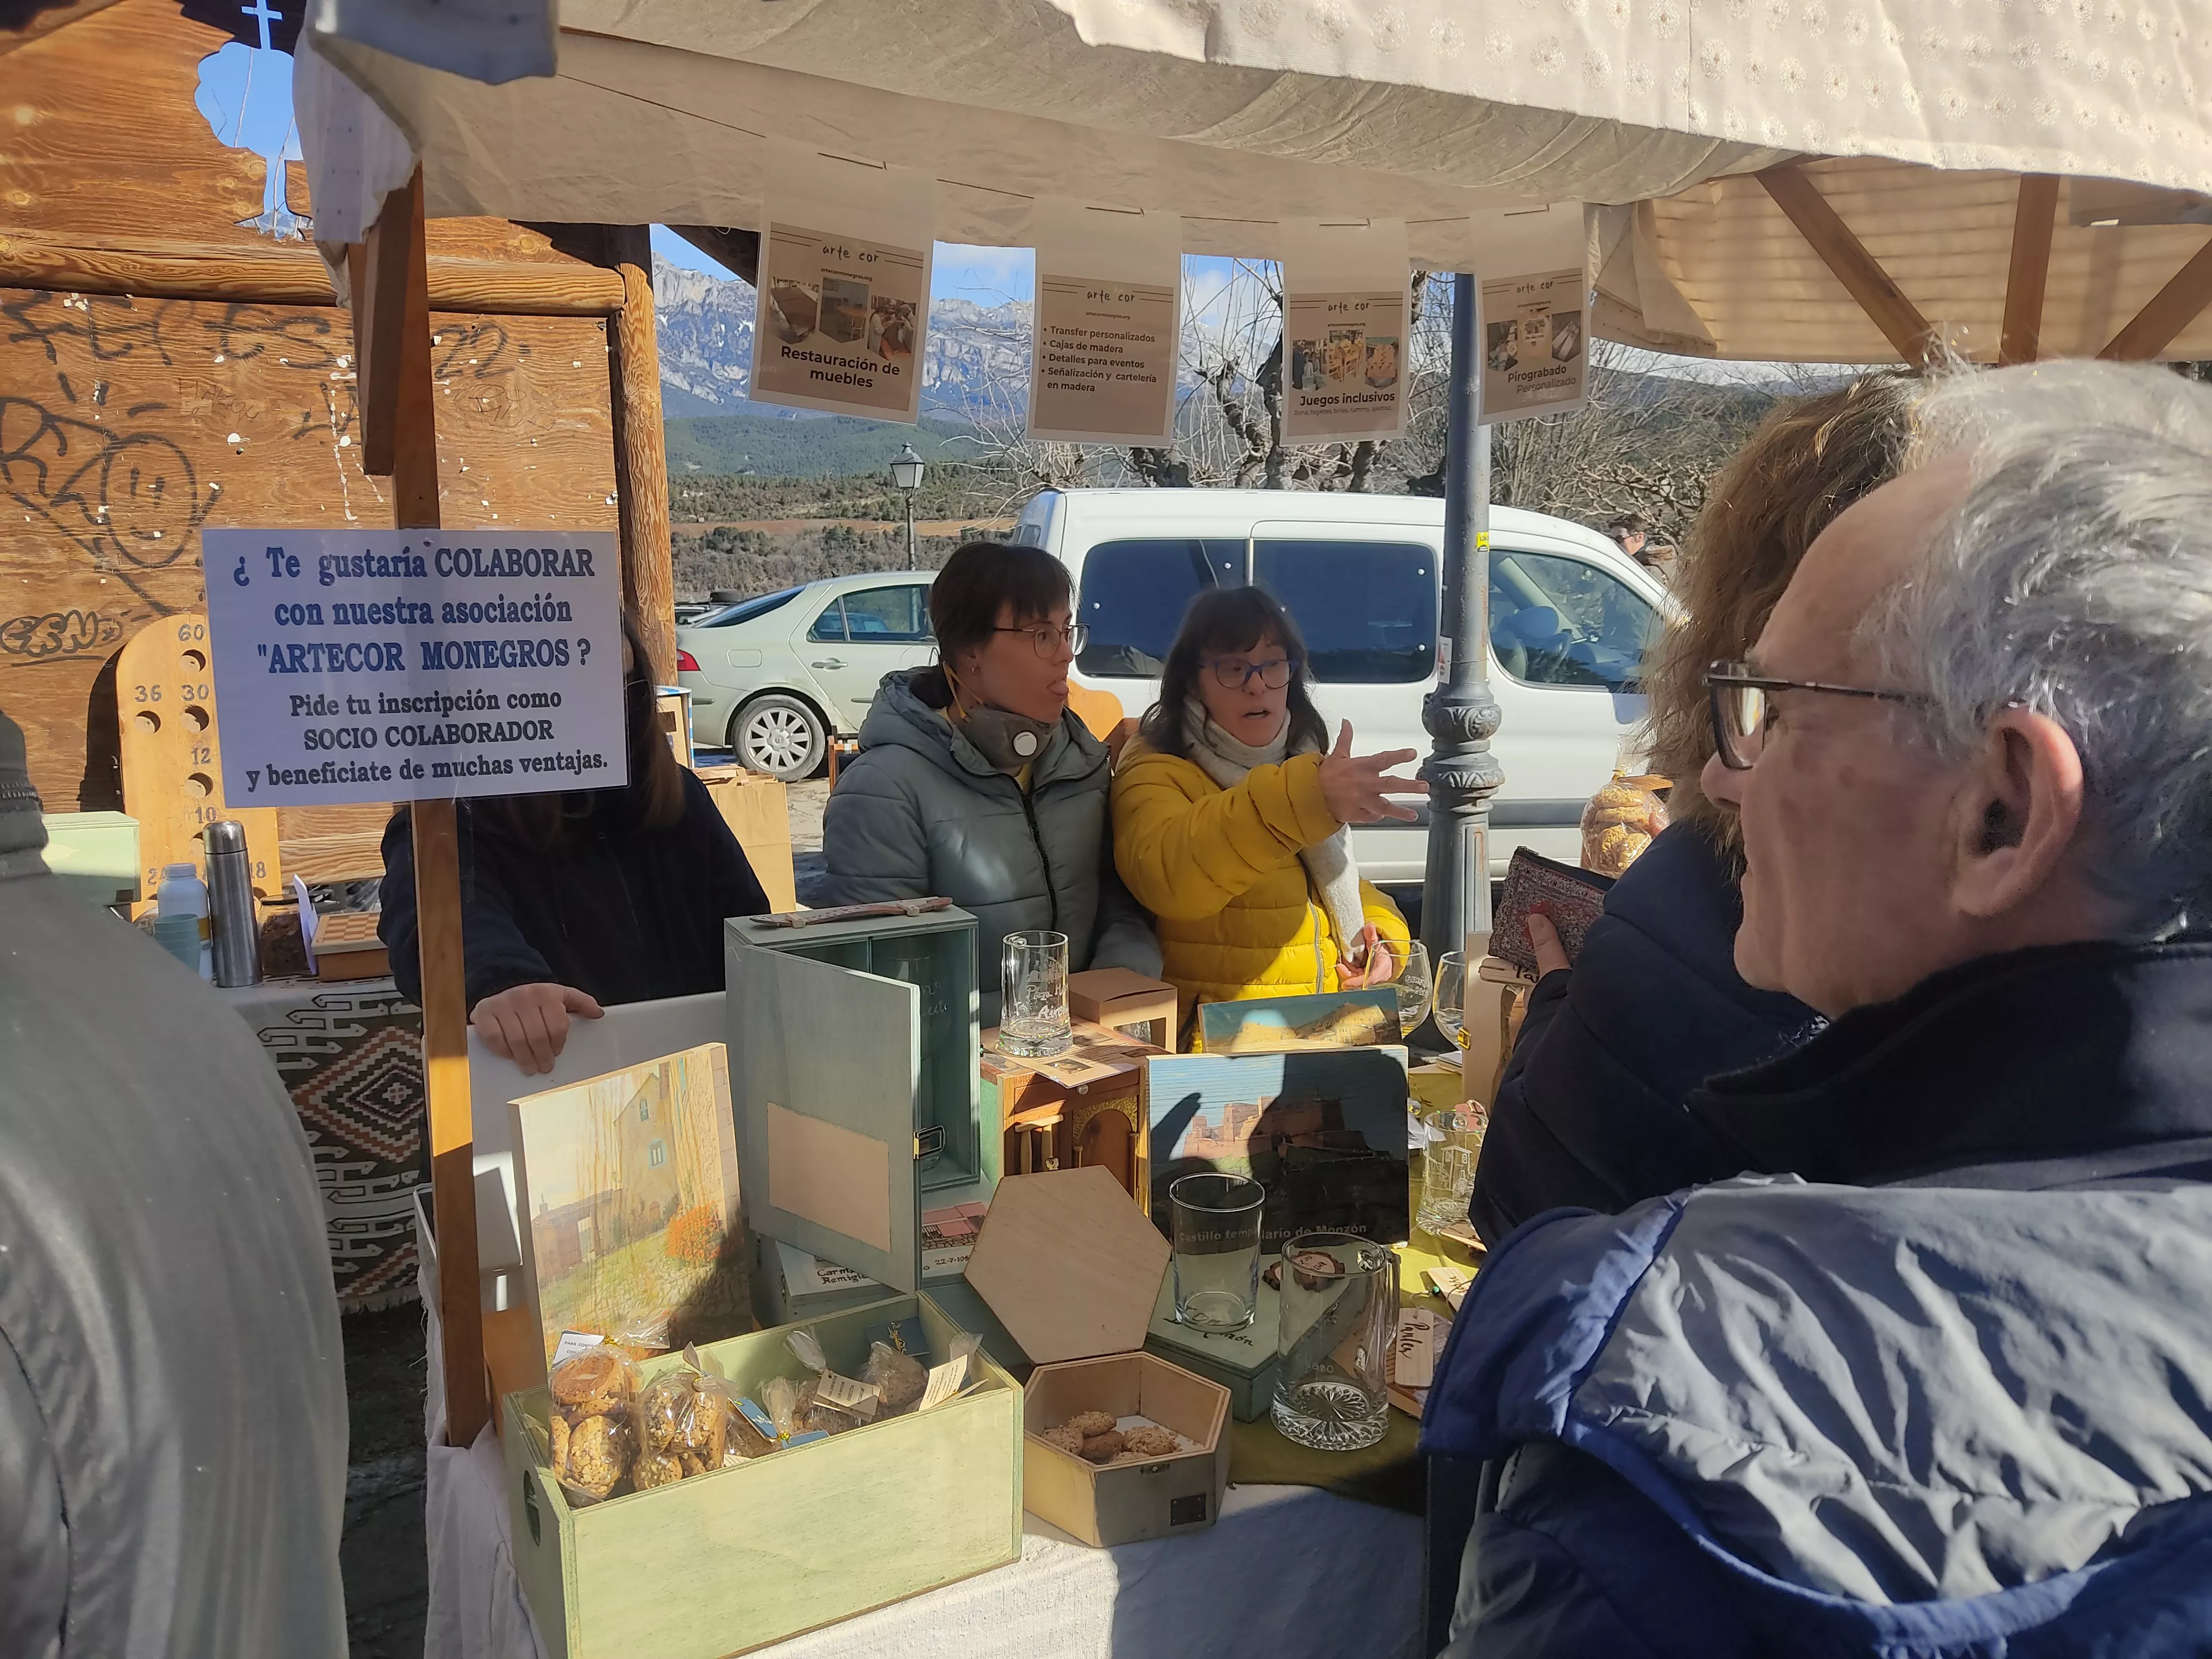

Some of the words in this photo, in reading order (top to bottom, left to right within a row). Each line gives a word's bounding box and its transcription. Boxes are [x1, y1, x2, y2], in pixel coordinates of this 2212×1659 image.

[822, 244, 851, 262] arte
[858, 252, 879, 263] cor
[1517, 283, 1535, 294] arte
[1541, 281, 1553, 290] cor
[1087, 290, 1111, 304] arte
[1118, 293, 1135, 302] cor
[1328, 301, 1349, 314] arte
[1354, 302, 1370, 311] cor
[1050, 326, 1088, 337] Transfer
[1089, 329, 1155, 342] personalizados
[1050, 340, 1074, 350] Cajas
[1076, 341, 1088, 350] de
[1089, 344, 1124, 353] madera
[781, 345, 878, 373] Restauración
[881, 361, 900, 375] de
[1048, 353, 1086, 364] Detalles
[1087, 357, 1108, 367] para
[1109, 360, 1145, 368] eventos
[810, 369, 873, 388] muebles
[1048, 367, 1104, 379] Señalización
[1115, 372, 1157, 383] cartelería
[1507, 364, 1567, 383] Pirograbado
[1061, 383, 1095, 392] madera
[1517, 376, 1576, 394] Personalizado
[1300, 395, 1340, 407] Juegos
[1342, 391, 1395, 404] inclusivos
[266, 546, 300, 578] Te
[319, 546, 427, 586] gustaría
[434, 548, 594, 578] COLABORAR
[274, 601, 324, 626] con
[333, 597, 434, 625] nuestra
[442, 593, 572, 624] asociación
[178, 624, 205, 642] 60
[257, 641, 405, 674] "ARTECOR
[421, 638, 570, 671] MONEGROS
[576, 637, 591, 665] ?
[134, 684, 163, 703] 36
[181, 684, 209, 702] 30
[289, 692, 340, 718] Pide
[346, 693, 371, 716] tu
[378, 688, 500, 717] inscripción
[507, 691, 562, 709] como
[304, 726, 378, 751] SOCIO
[384, 719, 554, 747] COLABORADOR
[191, 747, 212, 765] 12
[246, 770, 260, 792] y
[399, 758, 425, 780] de
[431, 755, 514, 778] muchas
[519, 749, 608, 774] ventajas.
[195, 806, 217, 824] 10
[1179, 1230, 1222, 1242] Castillo
